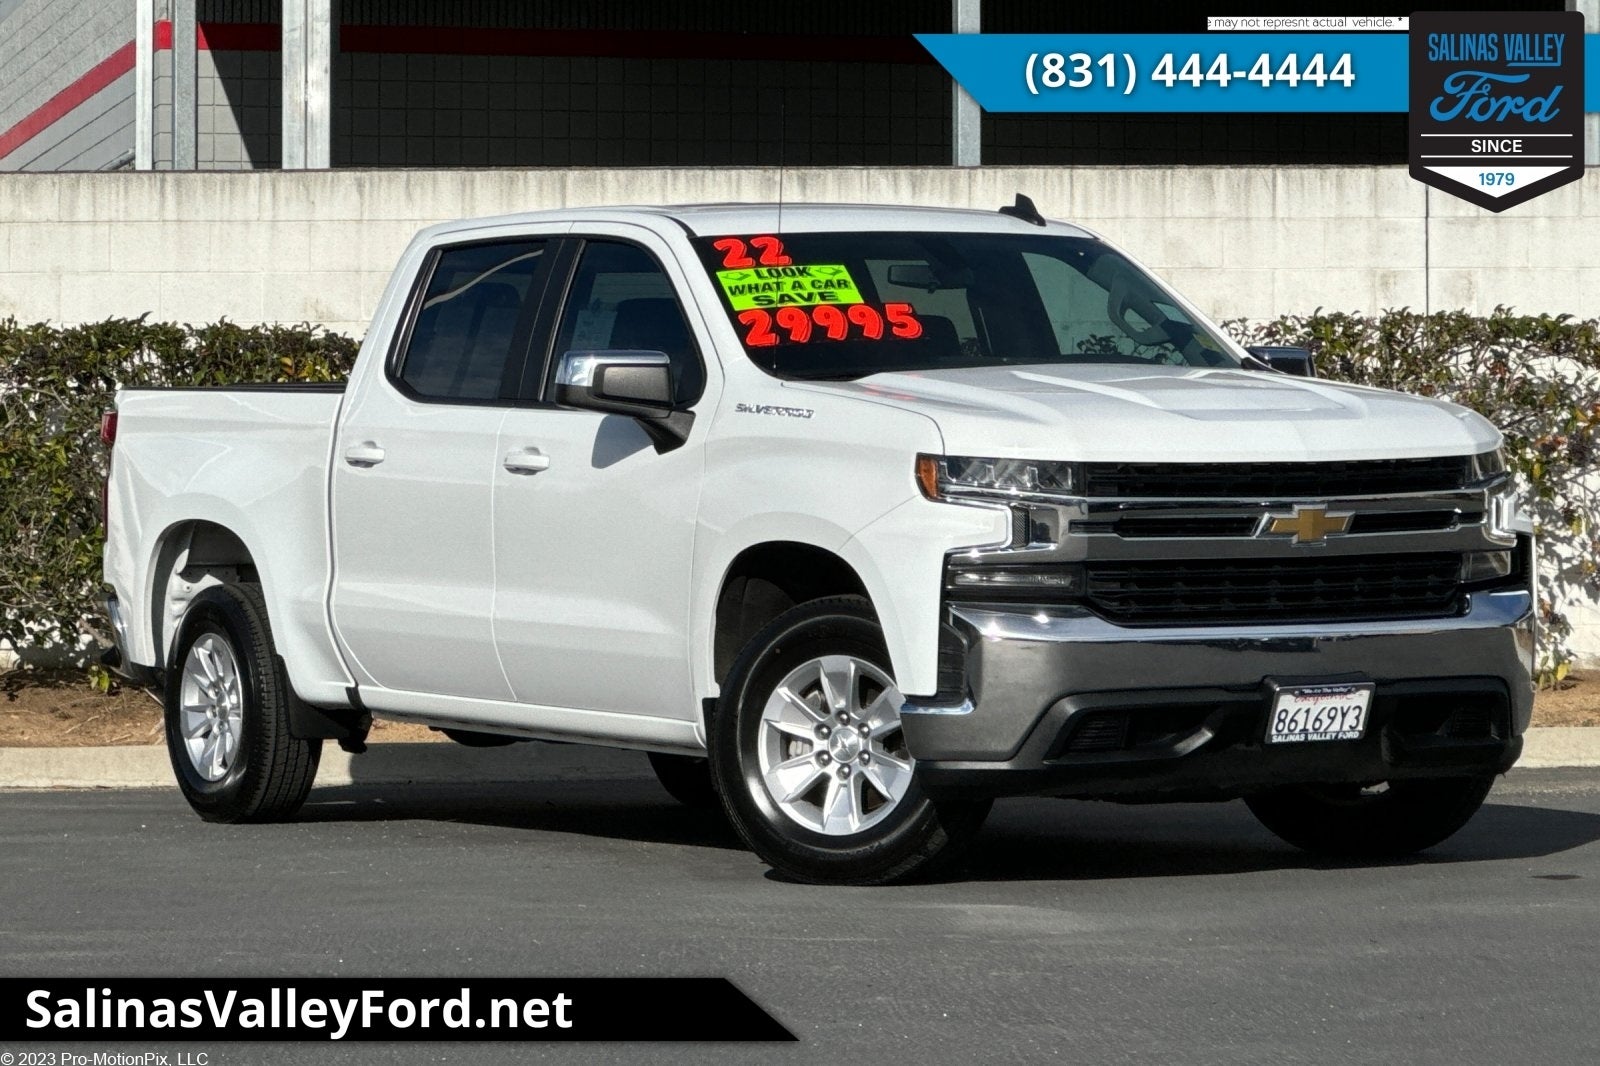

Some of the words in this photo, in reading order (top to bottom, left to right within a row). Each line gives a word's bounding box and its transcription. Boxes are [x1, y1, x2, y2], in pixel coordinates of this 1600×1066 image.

[713, 236, 793, 269] 22
[753, 266, 813, 280] LOOK
[727, 281, 785, 297] WHAT
[791, 279, 806, 291] A
[810, 278, 851, 290] CAR
[752, 291, 838, 306] SAVE
[737, 303, 923, 347] 29995
[1275, 705, 1363, 733] 86169Y3
[1272, 733, 1306, 743] SALINAS
[1307, 732, 1337, 741] VALLEY
[1338, 730, 1360, 739] FORD
